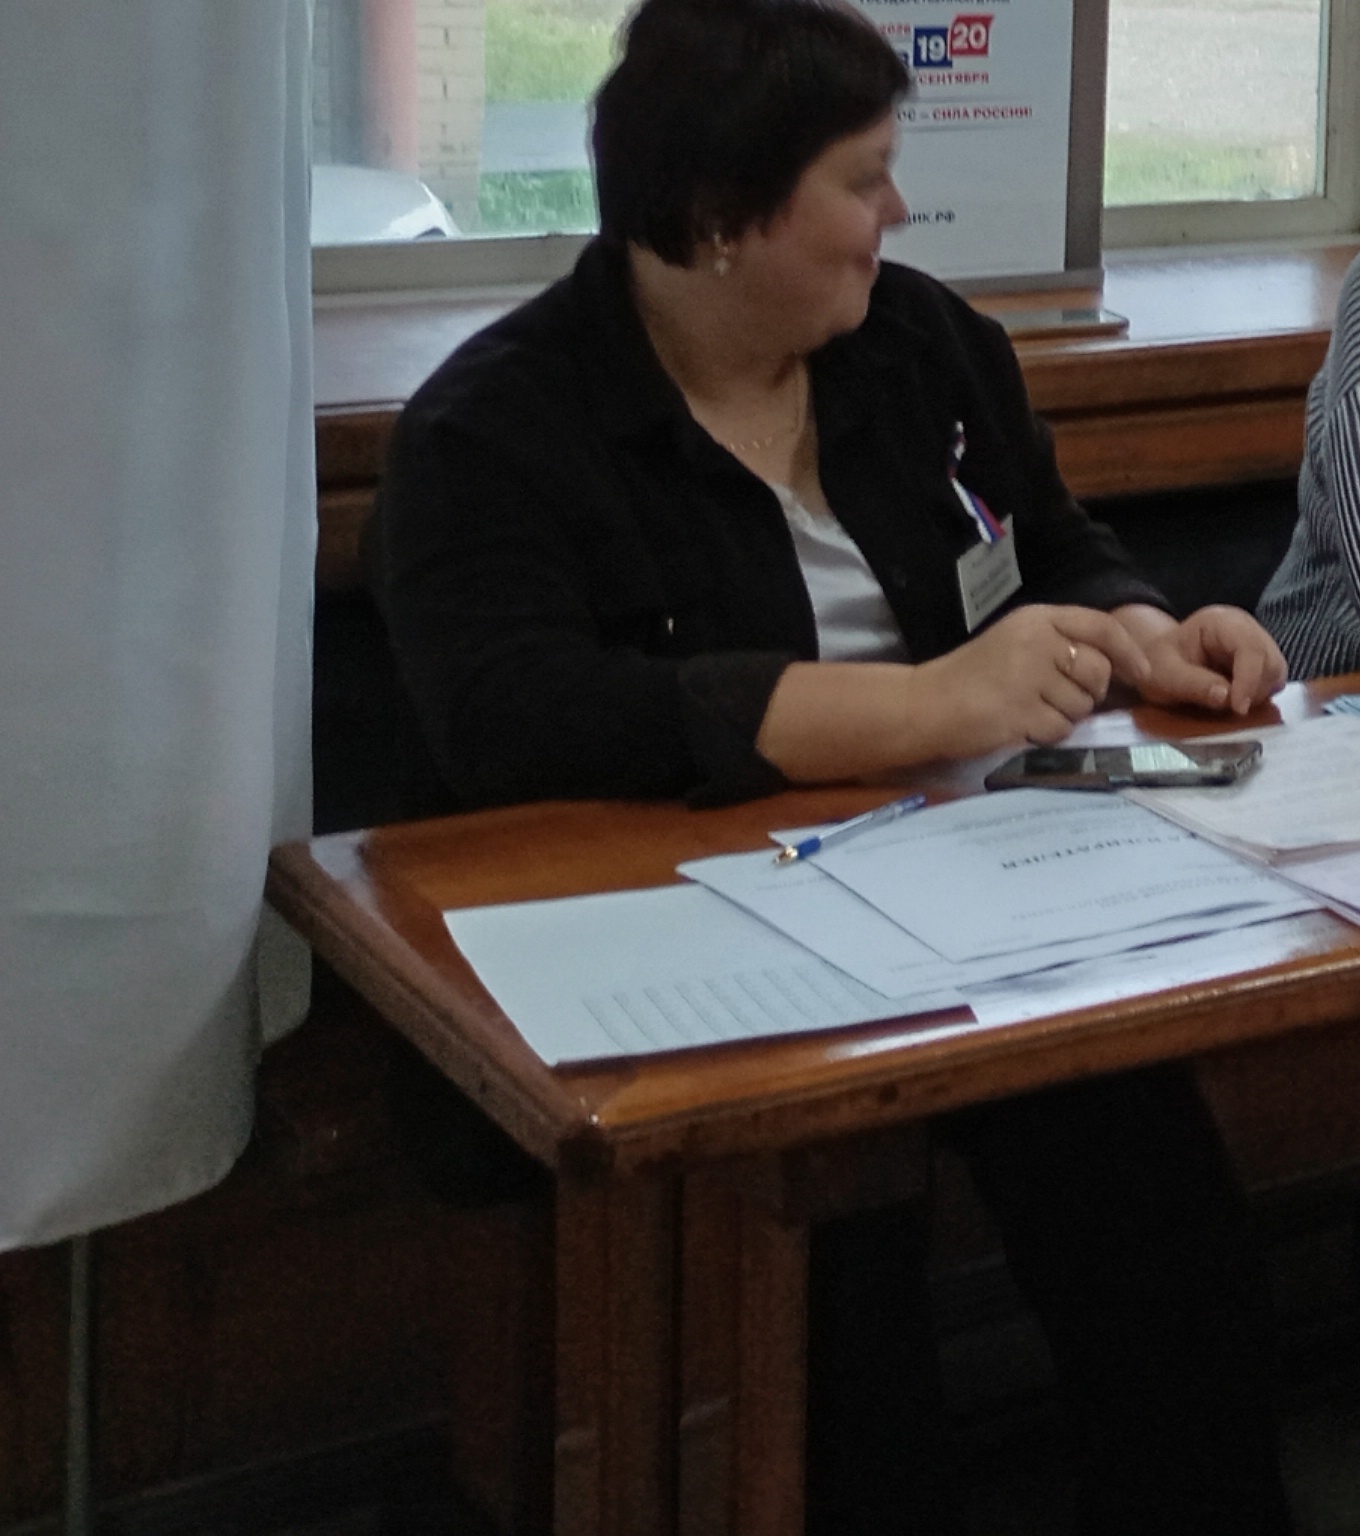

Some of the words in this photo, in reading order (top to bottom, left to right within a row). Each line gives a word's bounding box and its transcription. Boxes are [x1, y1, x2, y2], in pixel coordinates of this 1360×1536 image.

[916, 35, 946, 63] 19
[951, 23, 988, 50] 20
[918, 72, 989, 84] СЕНТЯБРЯ
[932, 108, 970, 120] СИЛА
